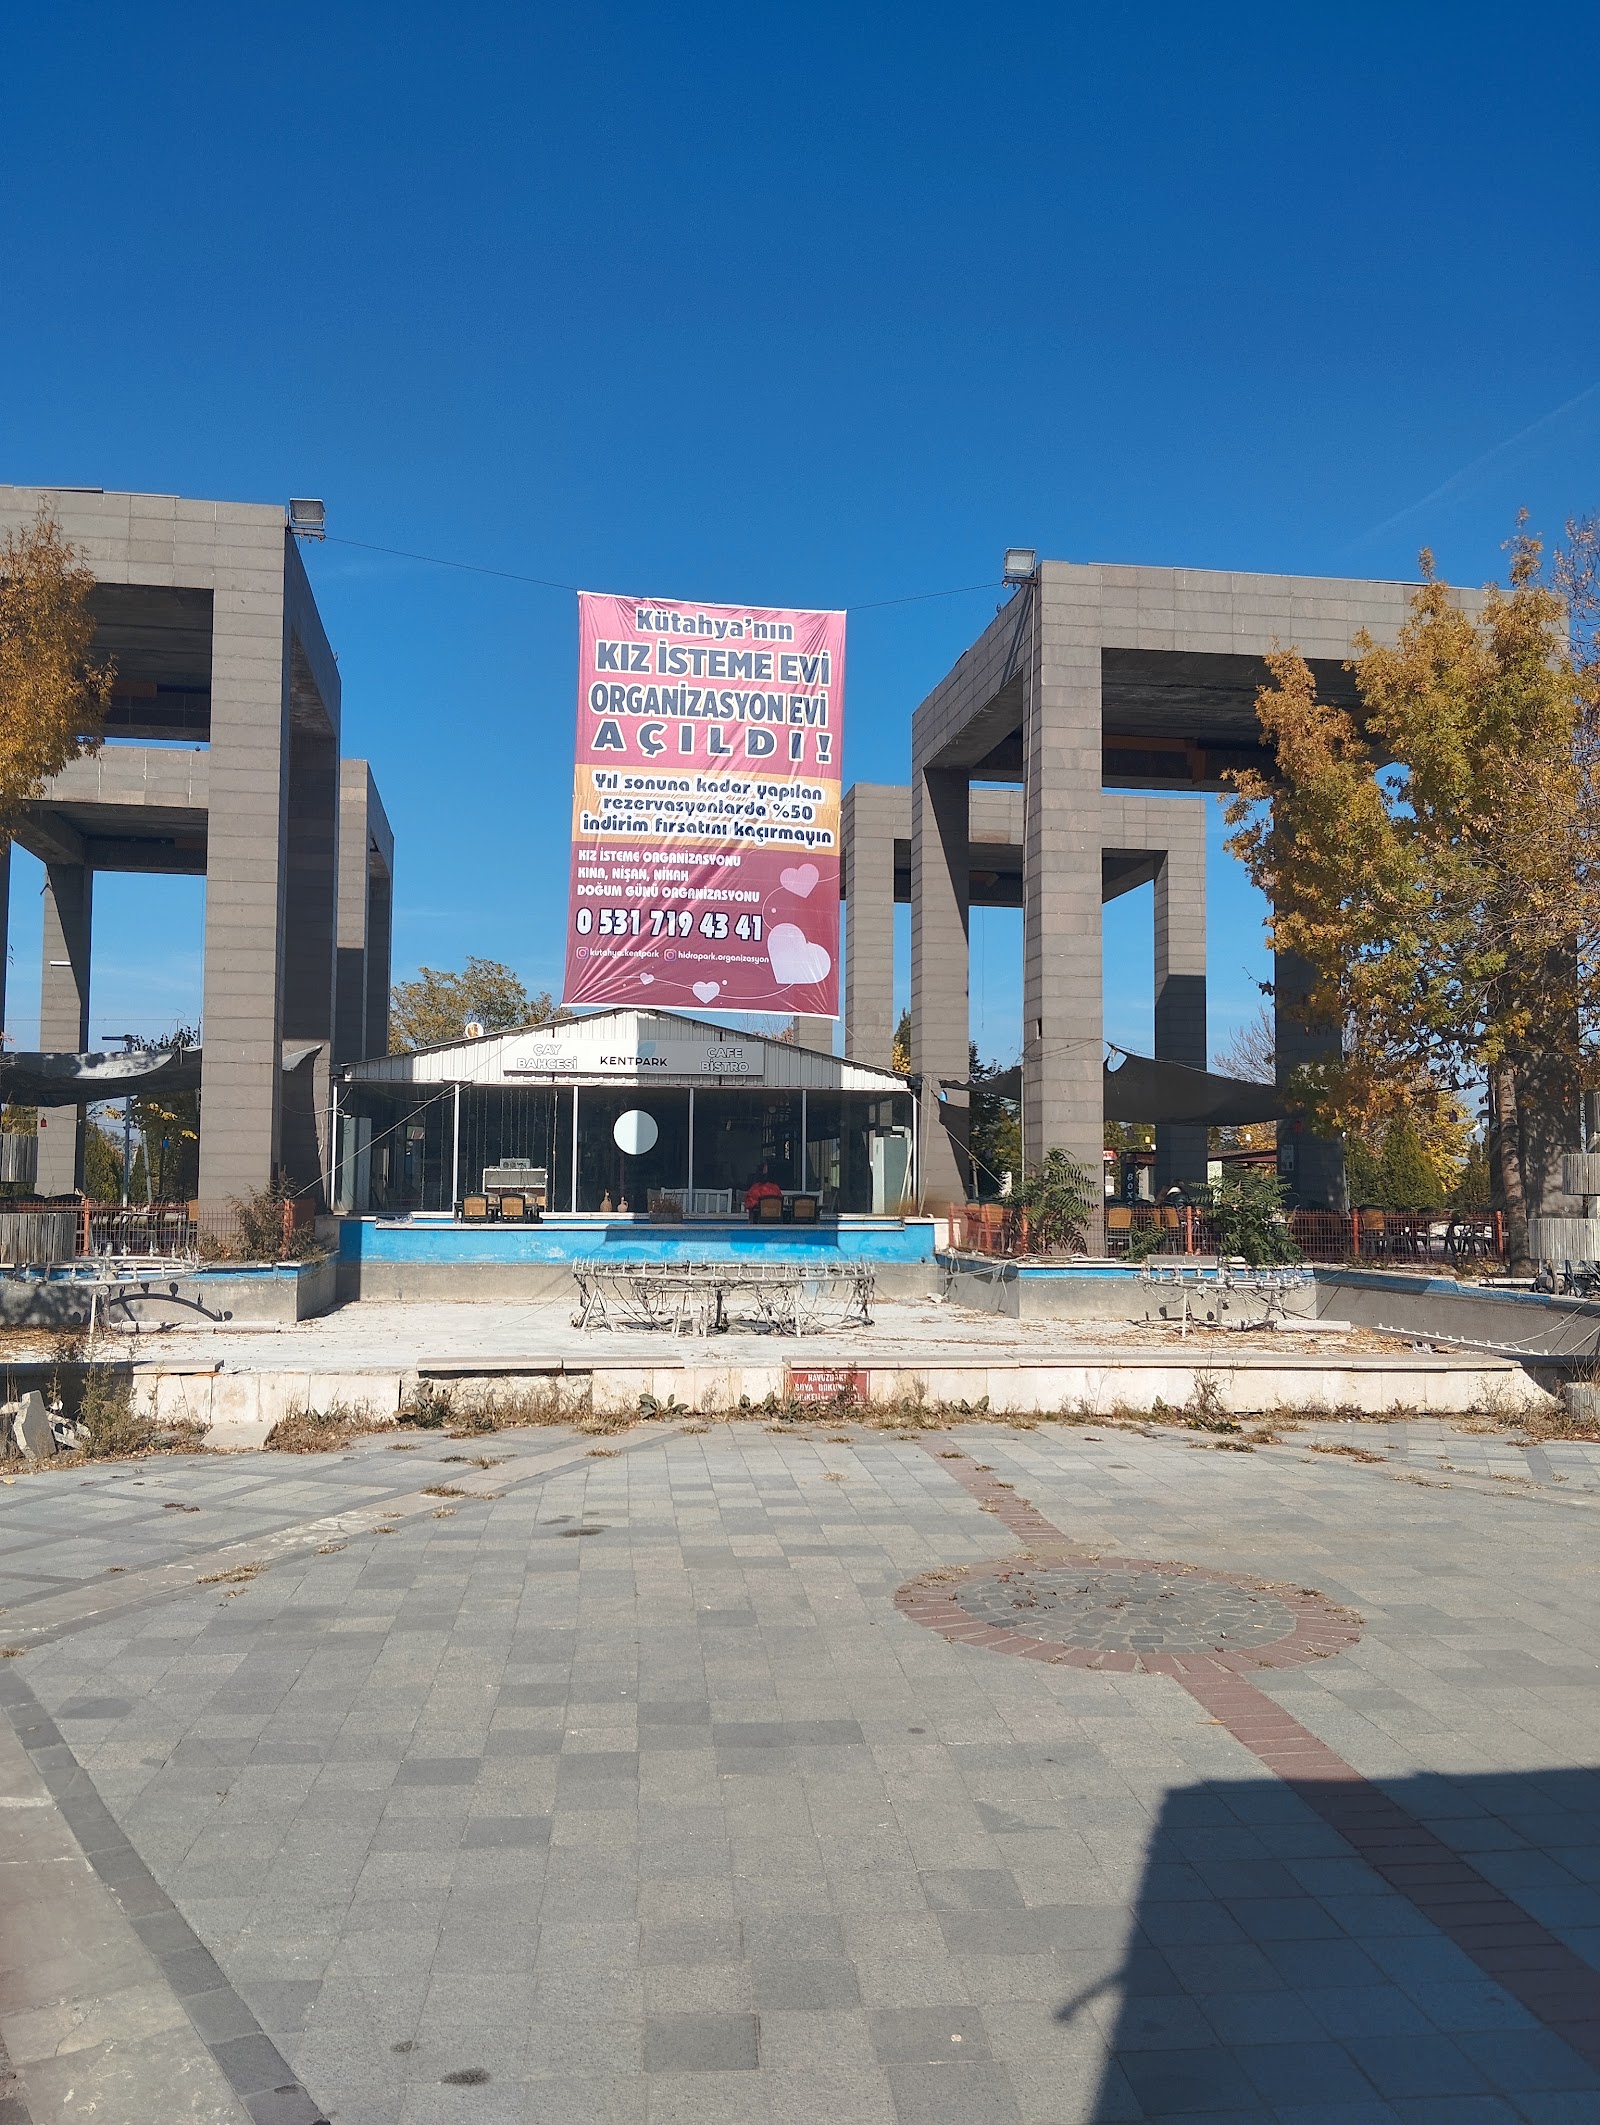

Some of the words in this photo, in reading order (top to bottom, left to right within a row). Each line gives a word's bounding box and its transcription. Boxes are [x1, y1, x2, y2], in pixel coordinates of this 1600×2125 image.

[597, 641, 651, 673] KIZ
[657, 640, 772, 681] İSTEME
[780, 651, 830, 686] EVİ
[590, 682, 784, 722] ORGANİZASYON
[788, 692, 828, 728] EVİ
[595, 772, 618, 789] Yıl
[624, 775, 690, 793] sonuna
[696, 777, 751, 796] kadar
[756, 783, 822, 801] yapılan
[603, 796, 767, 817] rezervasyonlarda
[772, 803, 813, 821] %50
[583, 813, 649, 833] indirim
[655, 817, 728, 836] fırsatını
[733, 821, 832, 846] kaçırmayın
[578, 849, 597, 862] KIZ
[599, 847, 640, 863] İSTEME
[642, 850, 742, 868] ORGANİZASYONU
[577, 867, 609, 881] KINA,
[611, 865, 650, 883] NİŞAN,
[653, 866, 690, 882] NİKAH
[577, 882, 622, 898] DOĞUM
[625, 882, 659, 899] GÜNÜ
[661, 886, 760, 904] ORGANİZASYONU
[576, 907, 594, 936] 0
[598, 908, 641, 937] 531
[650, 909, 695, 939] 719
[699, 911, 730, 940] 43
[734, 913, 763, 942] 41
[589, 947, 660, 960] kutahya.kentpark
[533, 1043, 562, 1056] ÇAY
[706, 1047, 744, 1059] CAFE
[599, 1055, 668, 1067] KENTPARK
[700, 1059, 750, 1073] BİSTRO
